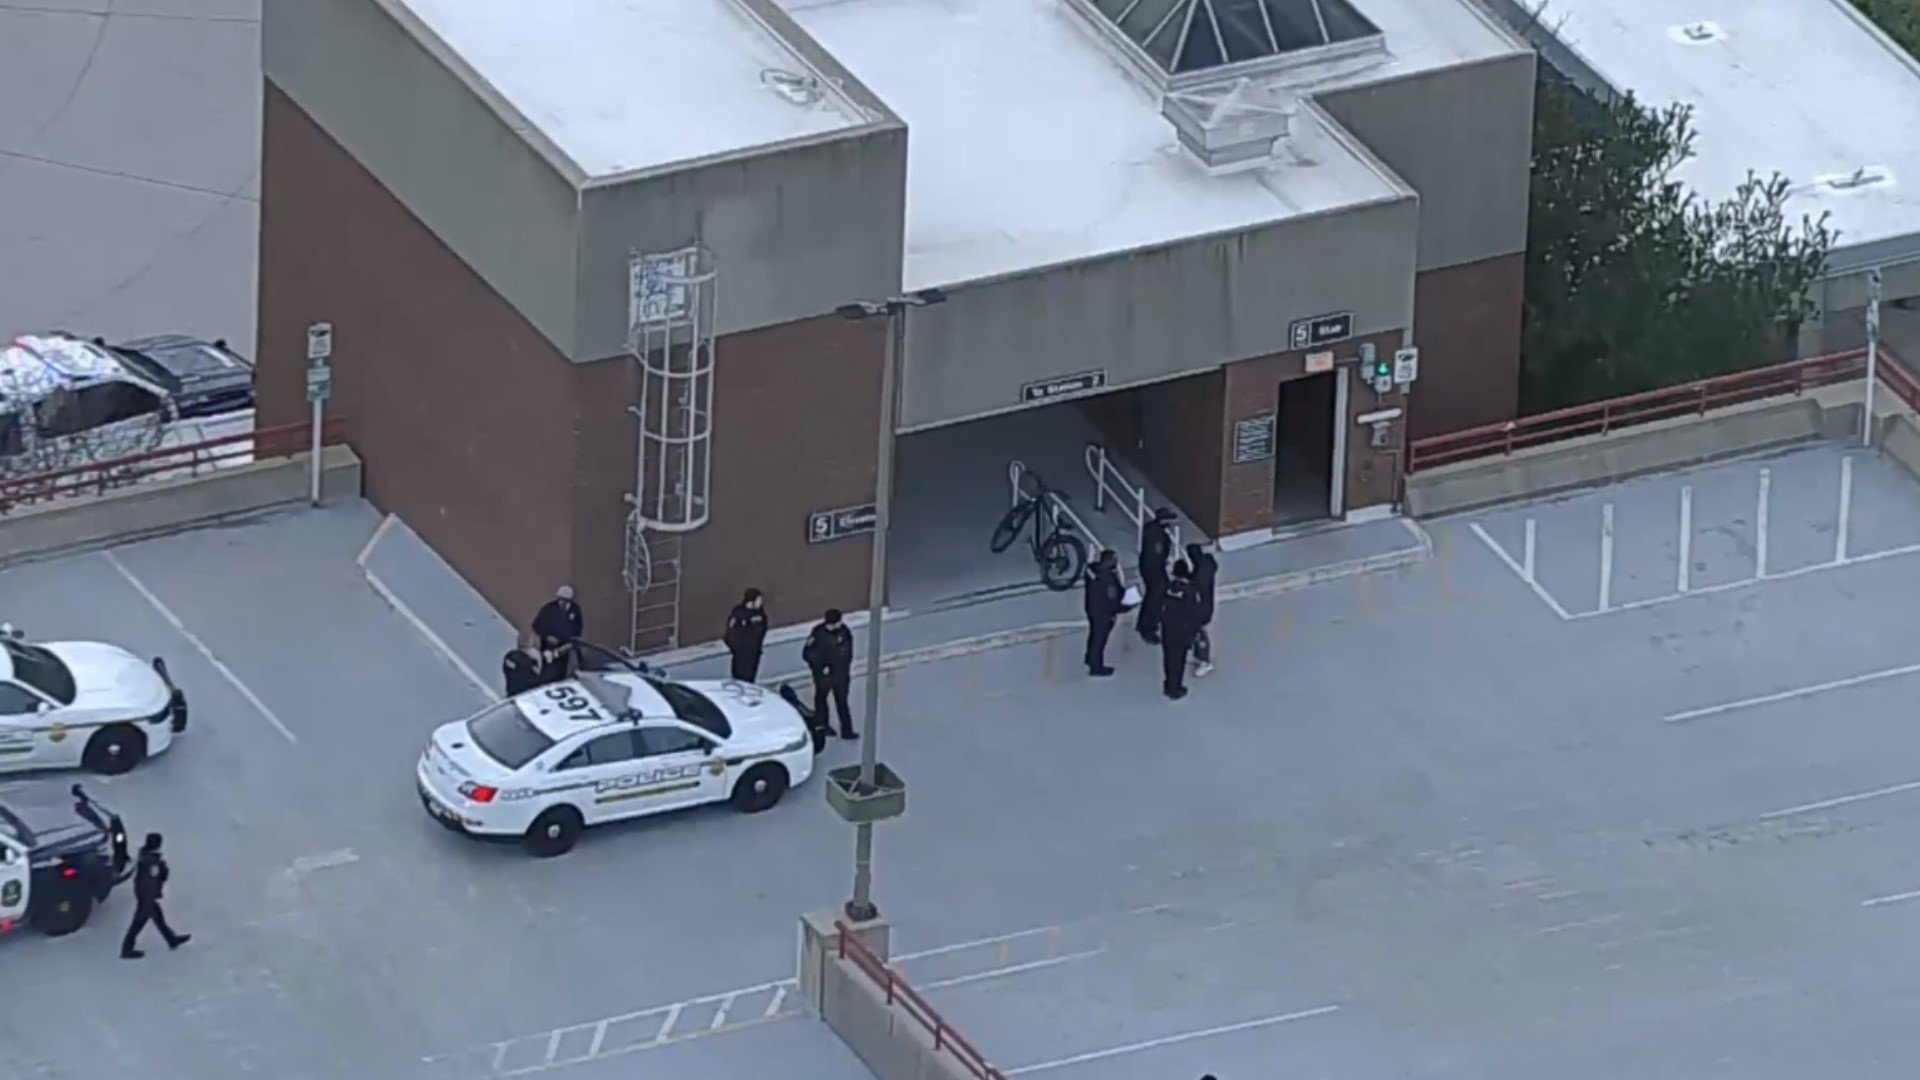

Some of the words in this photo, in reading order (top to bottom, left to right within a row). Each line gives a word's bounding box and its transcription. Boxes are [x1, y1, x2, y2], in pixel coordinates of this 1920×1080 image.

[1296, 325, 1308, 341] 5
[815, 516, 828, 533] 5
[545, 686, 602, 720] 597
[595, 763, 701, 793] POLICE
